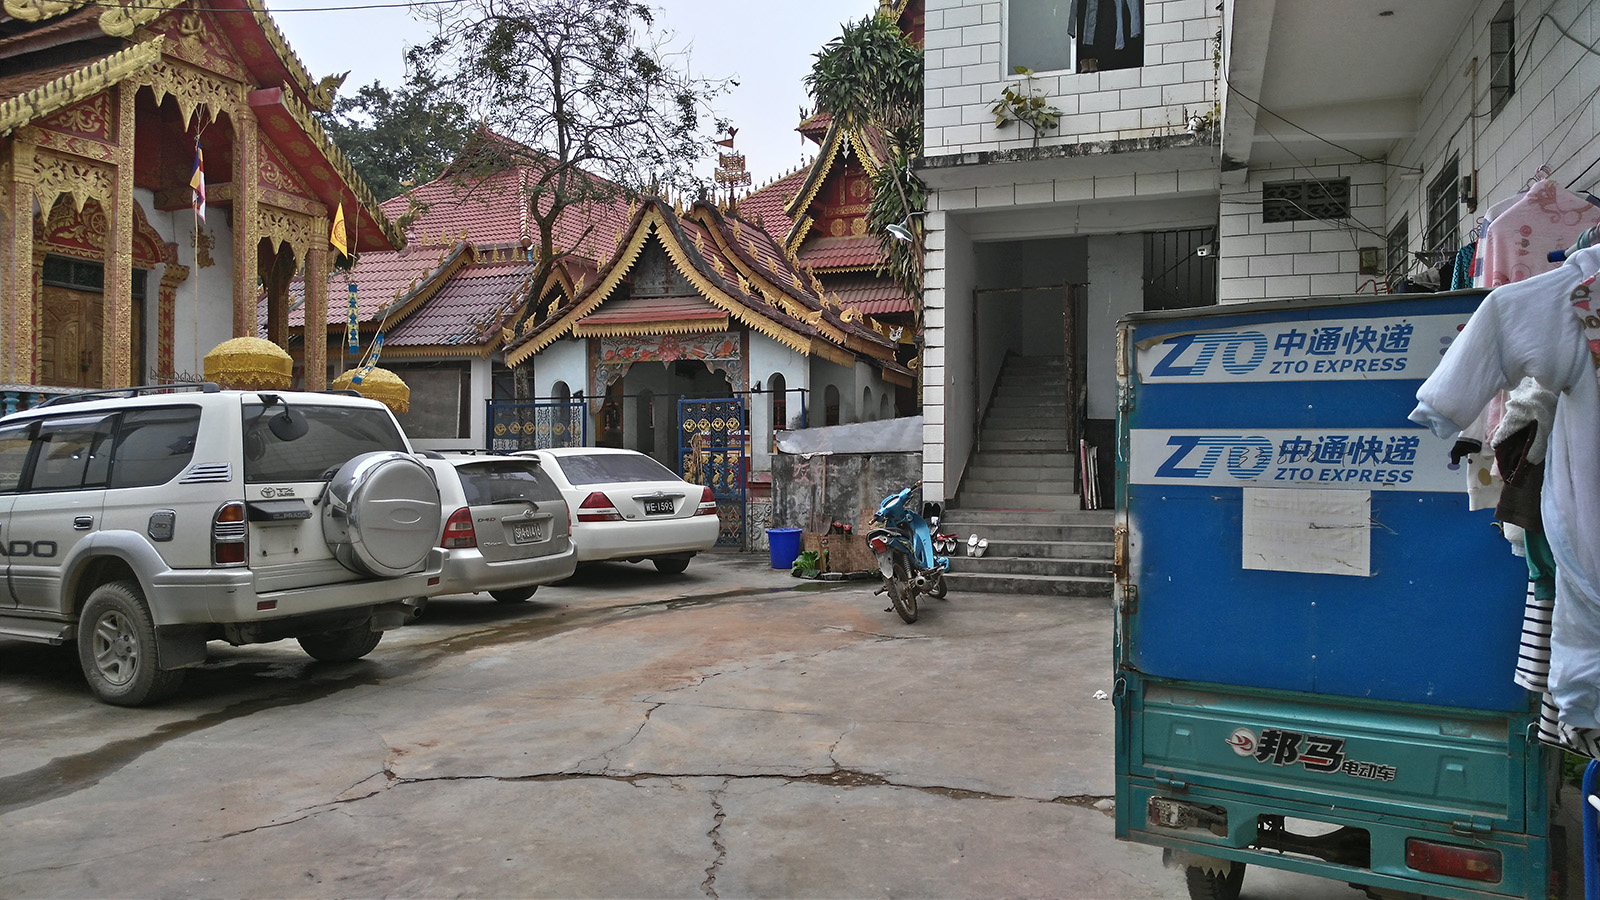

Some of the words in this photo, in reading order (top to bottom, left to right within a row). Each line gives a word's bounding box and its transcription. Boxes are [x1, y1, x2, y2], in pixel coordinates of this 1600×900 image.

[1150, 331, 1268, 377] ZTO
[1273, 324, 1414, 356] 中通快递
[1269, 358, 1308, 374] ZTO
[1313, 357, 1408, 373] EXPRESS
[1155, 435, 1273, 480] ZTO
[1278, 435, 1420, 466] 中通快递
[1274, 468, 1314, 481] ZTO
[1318, 468, 1414, 483] EXPRESS
[646, 501, 675, 513] WE-1593
[1253, 729, 1347, 774] 邦马
[1341, 759, 1397, 782] 电动车
